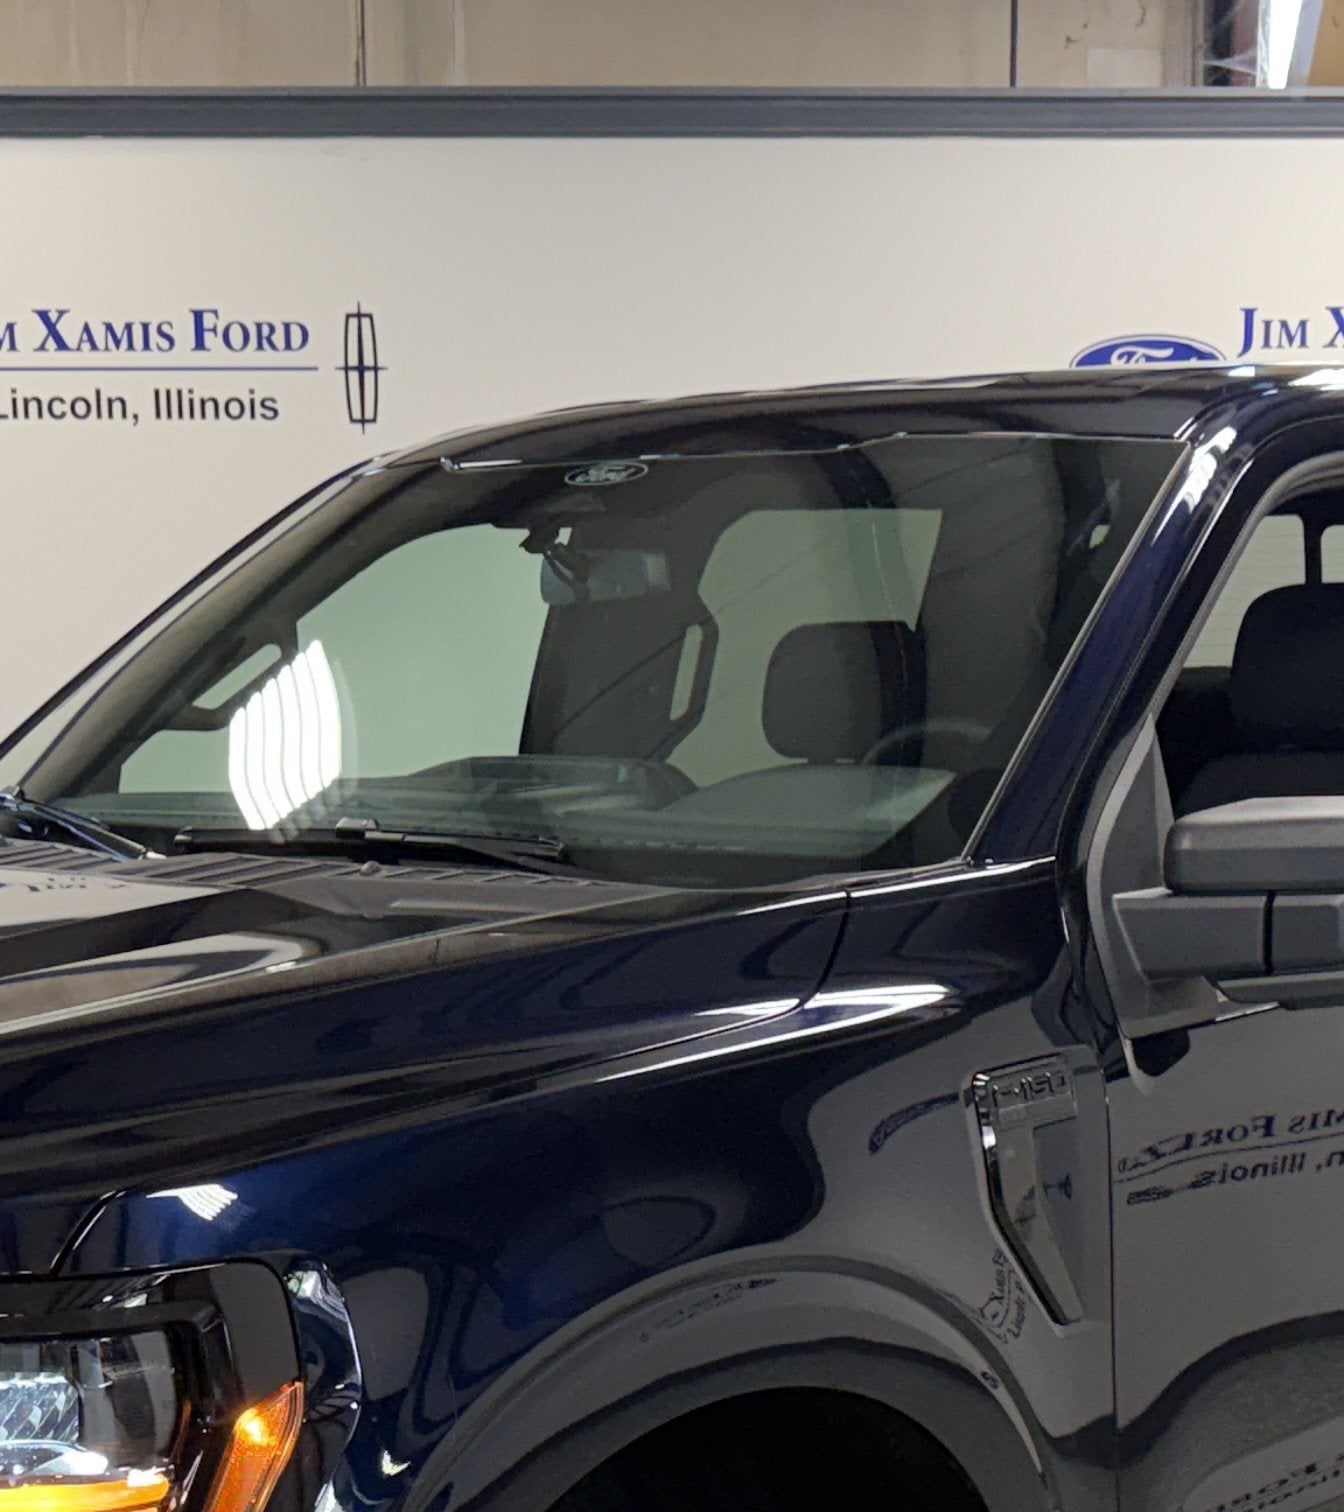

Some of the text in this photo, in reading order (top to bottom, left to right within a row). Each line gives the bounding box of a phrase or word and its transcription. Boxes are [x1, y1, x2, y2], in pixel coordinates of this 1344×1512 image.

[31, 308, 176, 353] XAMIS
[189, 308, 310, 353] FORD
[1237, 307, 1310, 358] JIM
[154, 387, 280, 421] Illinois
